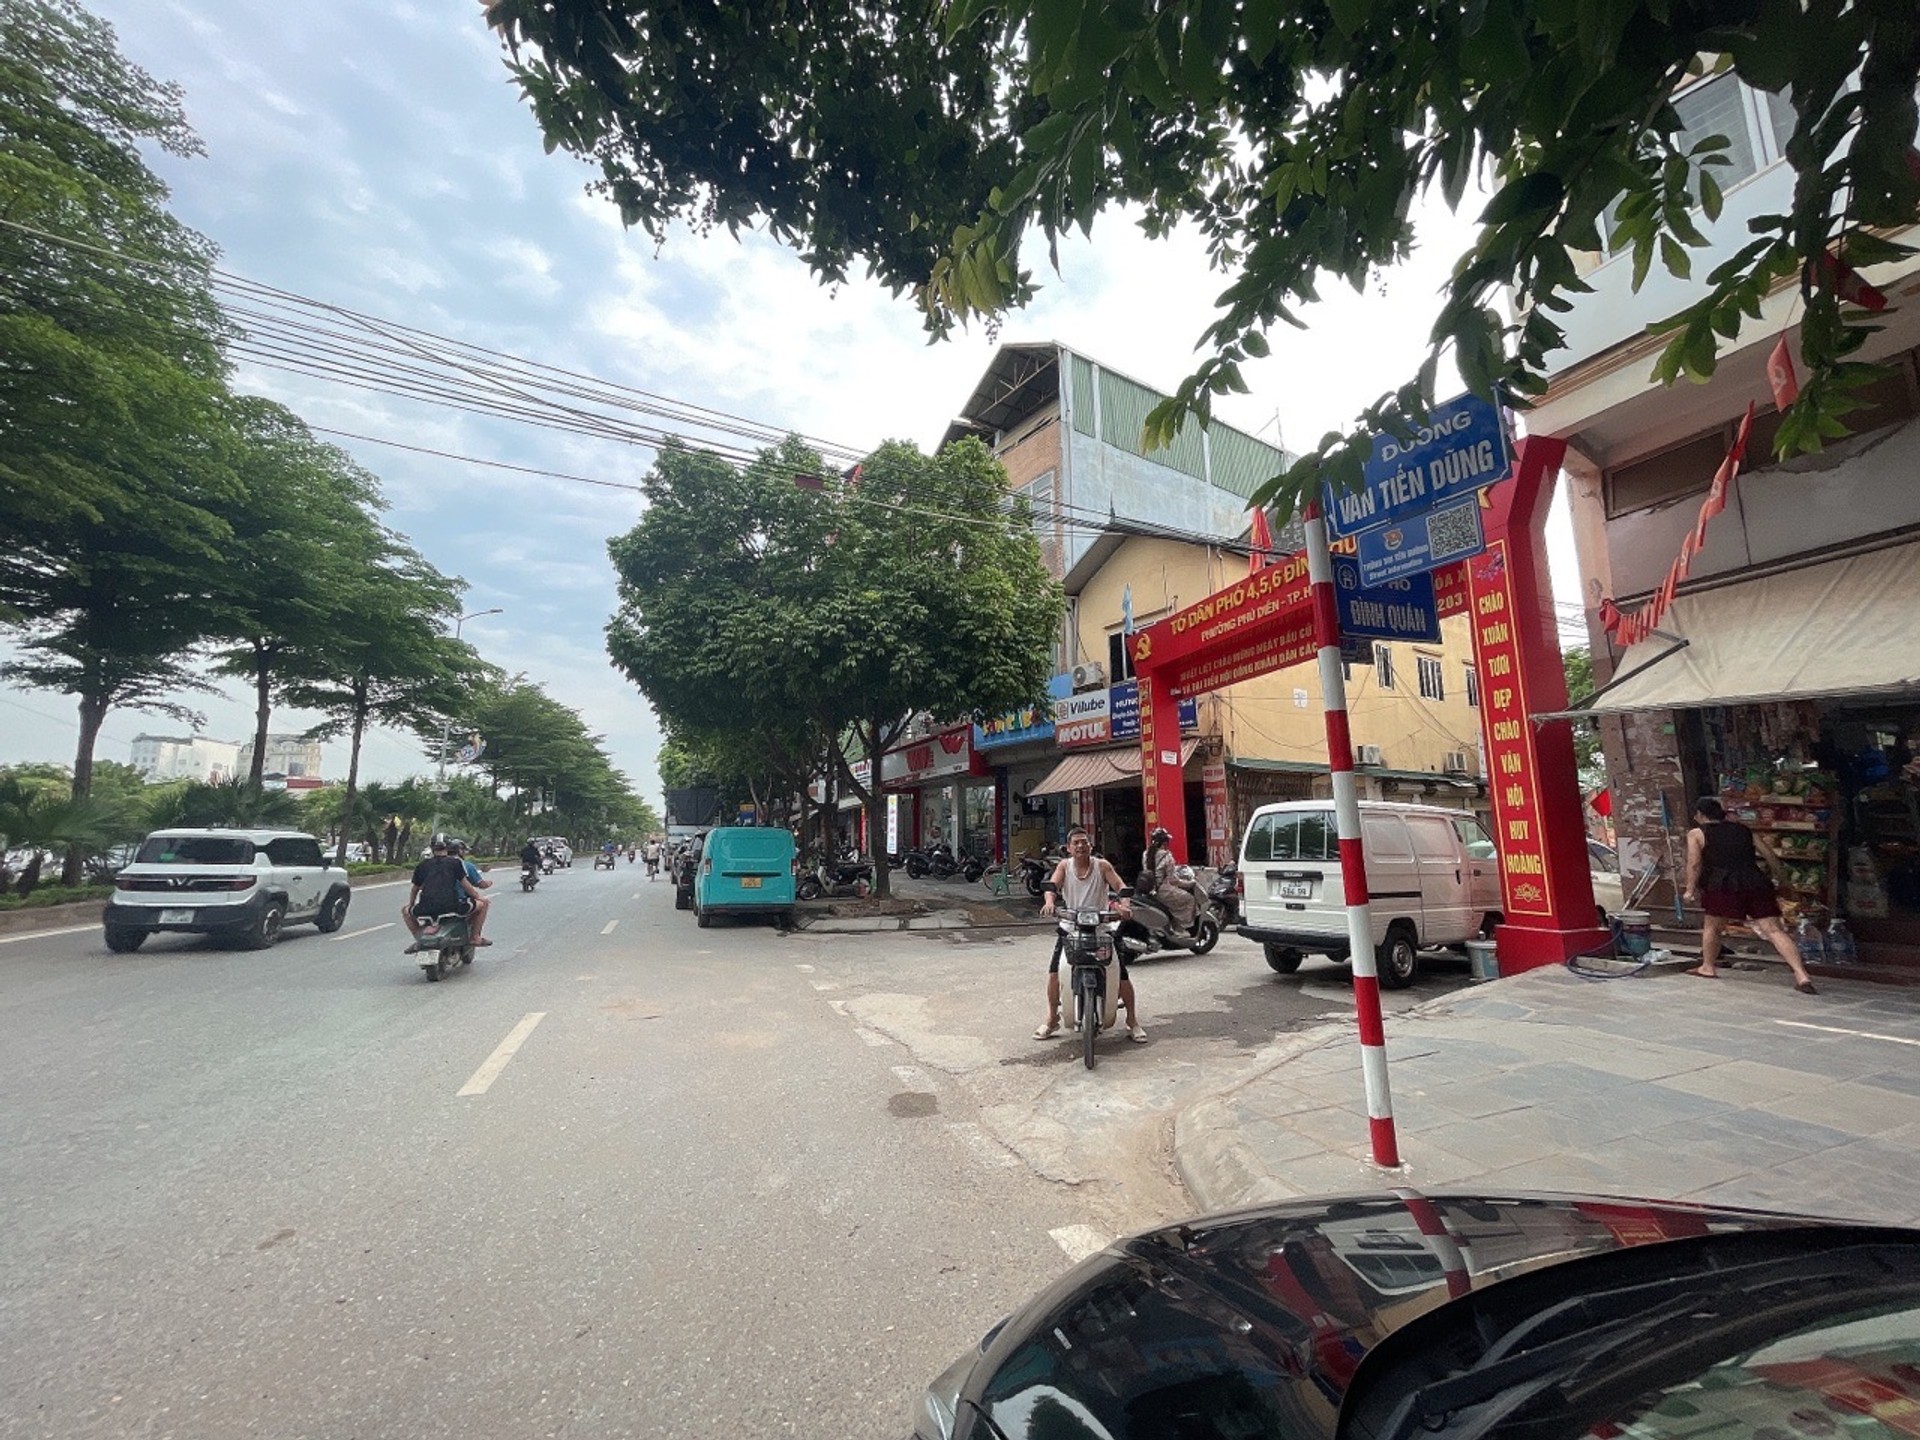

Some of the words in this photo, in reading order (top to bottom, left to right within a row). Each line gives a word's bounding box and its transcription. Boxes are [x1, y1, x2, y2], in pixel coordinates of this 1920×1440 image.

[1379, 463, 1426, 510] TIẾN
[1430, 439, 1495, 491] DŨNG
[1170, 613, 1187, 636] TỔ
[1187, 602, 1215, 628] DÂN
[1215, 584, 1246, 615] PHỐ
[1283, 556, 1309, 583] ĐÌN
[1478, 590, 1505, 615] CHÀO
[1350, 595, 1386, 628] ĐÌNH
[1387, 602, 1427, 633] QUÁN
[1201, 617, 1238, 642] PHƯỜNG
[1279, 629, 1298, 647] BẦU
[1482, 621, 1509, 647] XUÂN
[1254, 653, 1278, 671] NHÂN
[1278, 647, 1298, 664] DÂN
[1488, 654, 1511, 678] TƯƠI
[1070, 697, 1106, 716] Vilube
[1493, 688, 1512, 713] ĐẸP
[1058, 720, 1107, 743] MOTUL
[1493, 718, 1521, 742] CHÀO
[1500, 752, 1522, 778] VẬN
[1506, 785, 1525, 811] HỘI
[1509, 820, 1530, 841] HUY
[1506, 851, 1543, 876] HOÀNG
